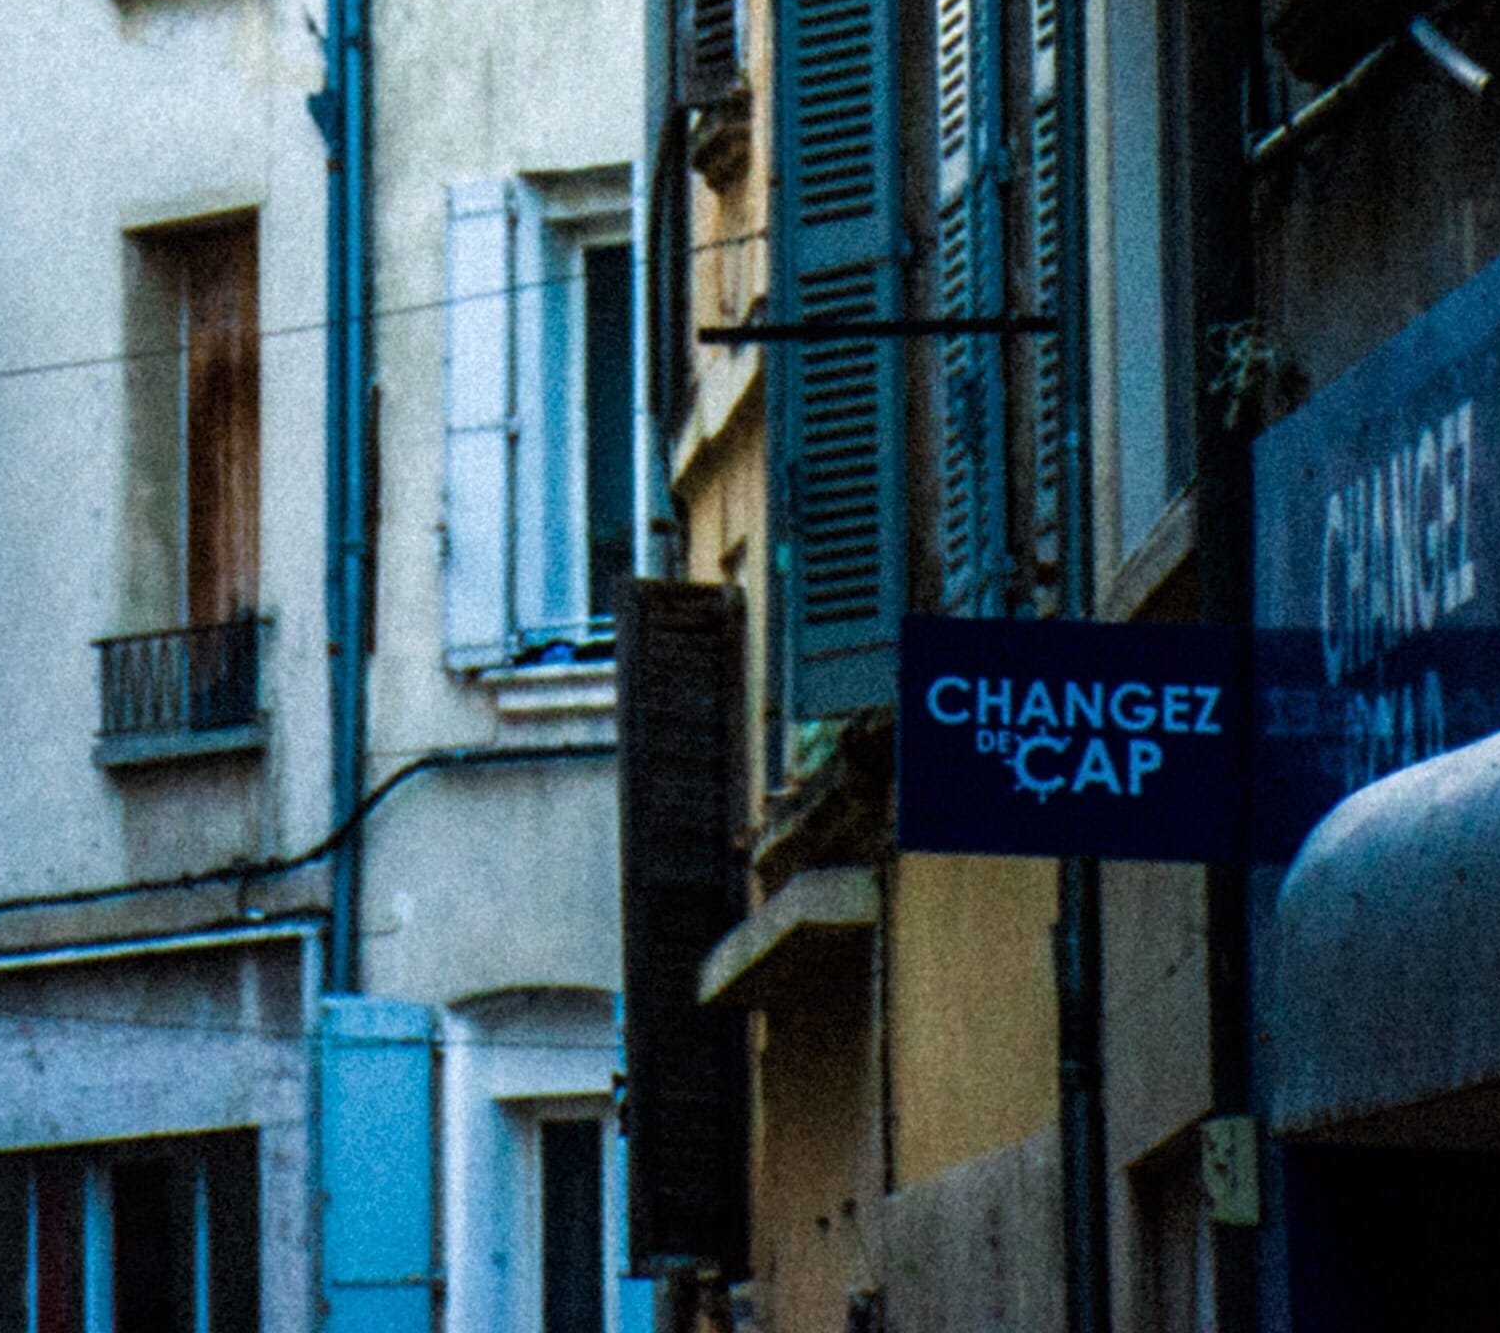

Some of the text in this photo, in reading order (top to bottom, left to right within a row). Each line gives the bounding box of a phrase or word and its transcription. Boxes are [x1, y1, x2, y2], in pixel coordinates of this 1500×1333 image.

[1320, 398, 1478, 688] CHANGEZ
[926, 676, 1223, 733] CHANGEZ
[976, 730, 1163, 799] DE CAP
